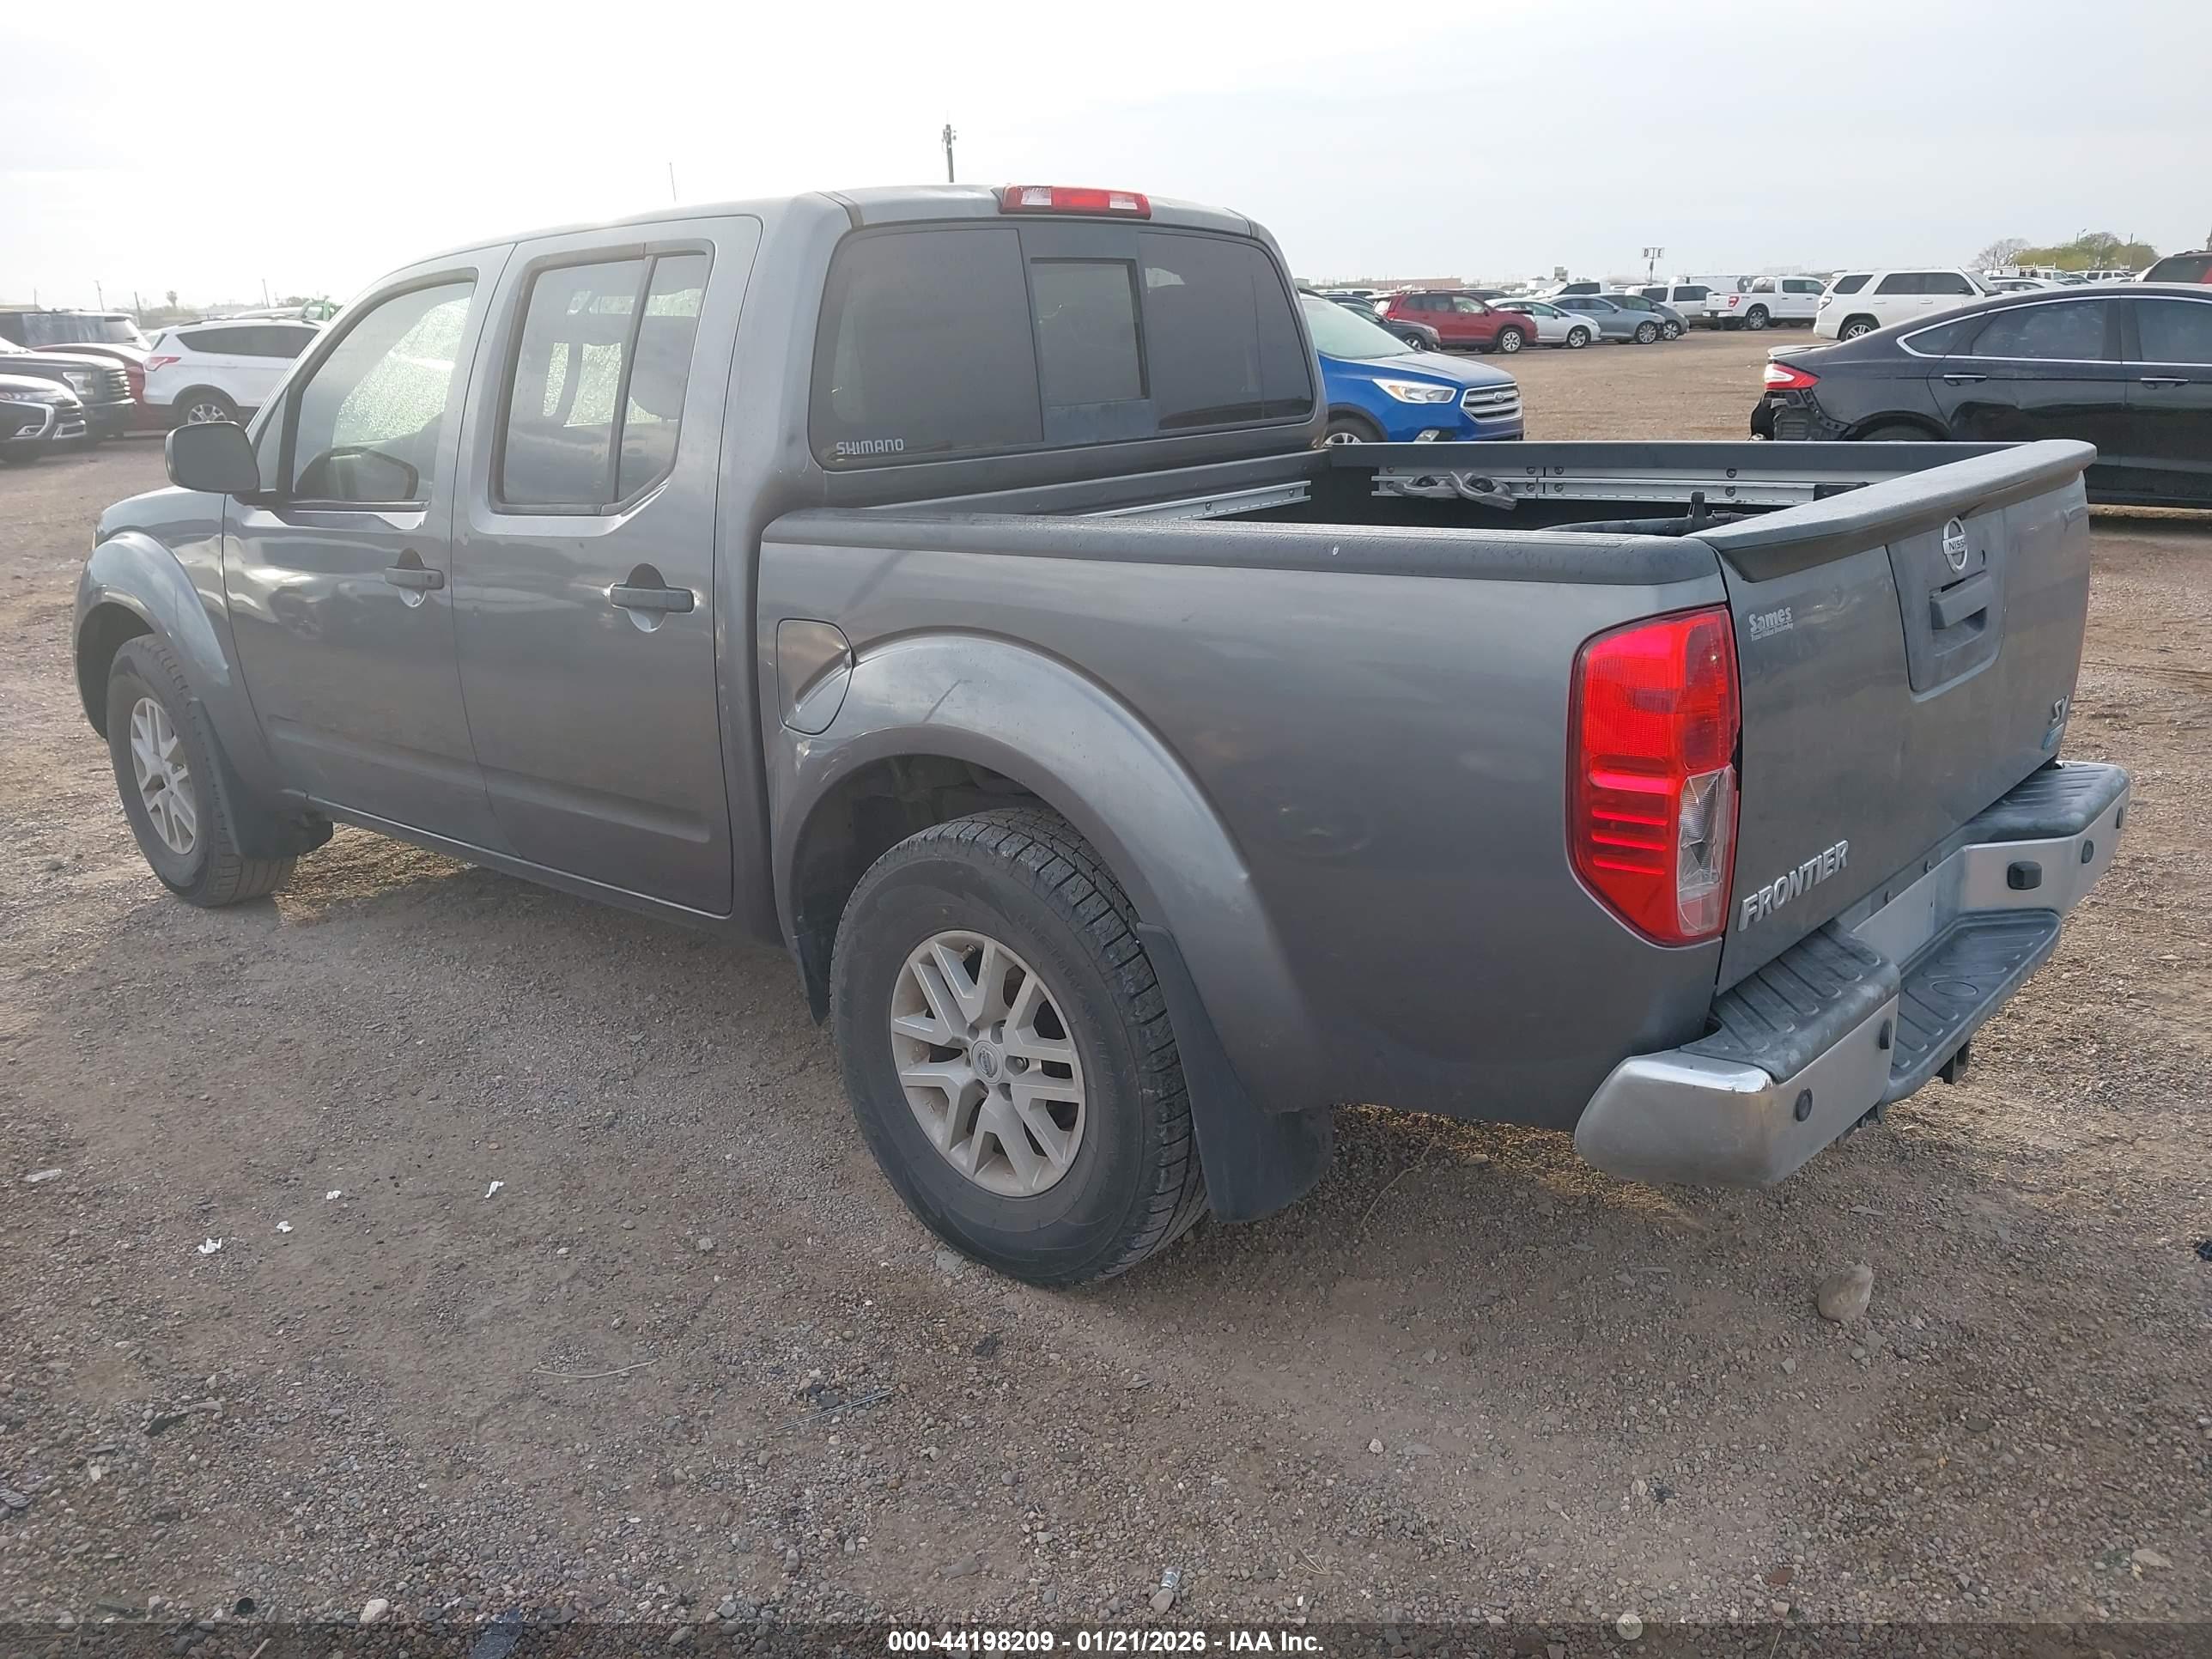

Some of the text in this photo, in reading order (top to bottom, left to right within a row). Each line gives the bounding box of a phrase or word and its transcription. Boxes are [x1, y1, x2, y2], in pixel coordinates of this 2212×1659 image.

[836, 438, 905, 455] SHIMANO
[1748, 606, 1792, 633] Sames
[2051, 694, 2069, 723] SV
[1737, 839, 1849, 933] FRONTIER
